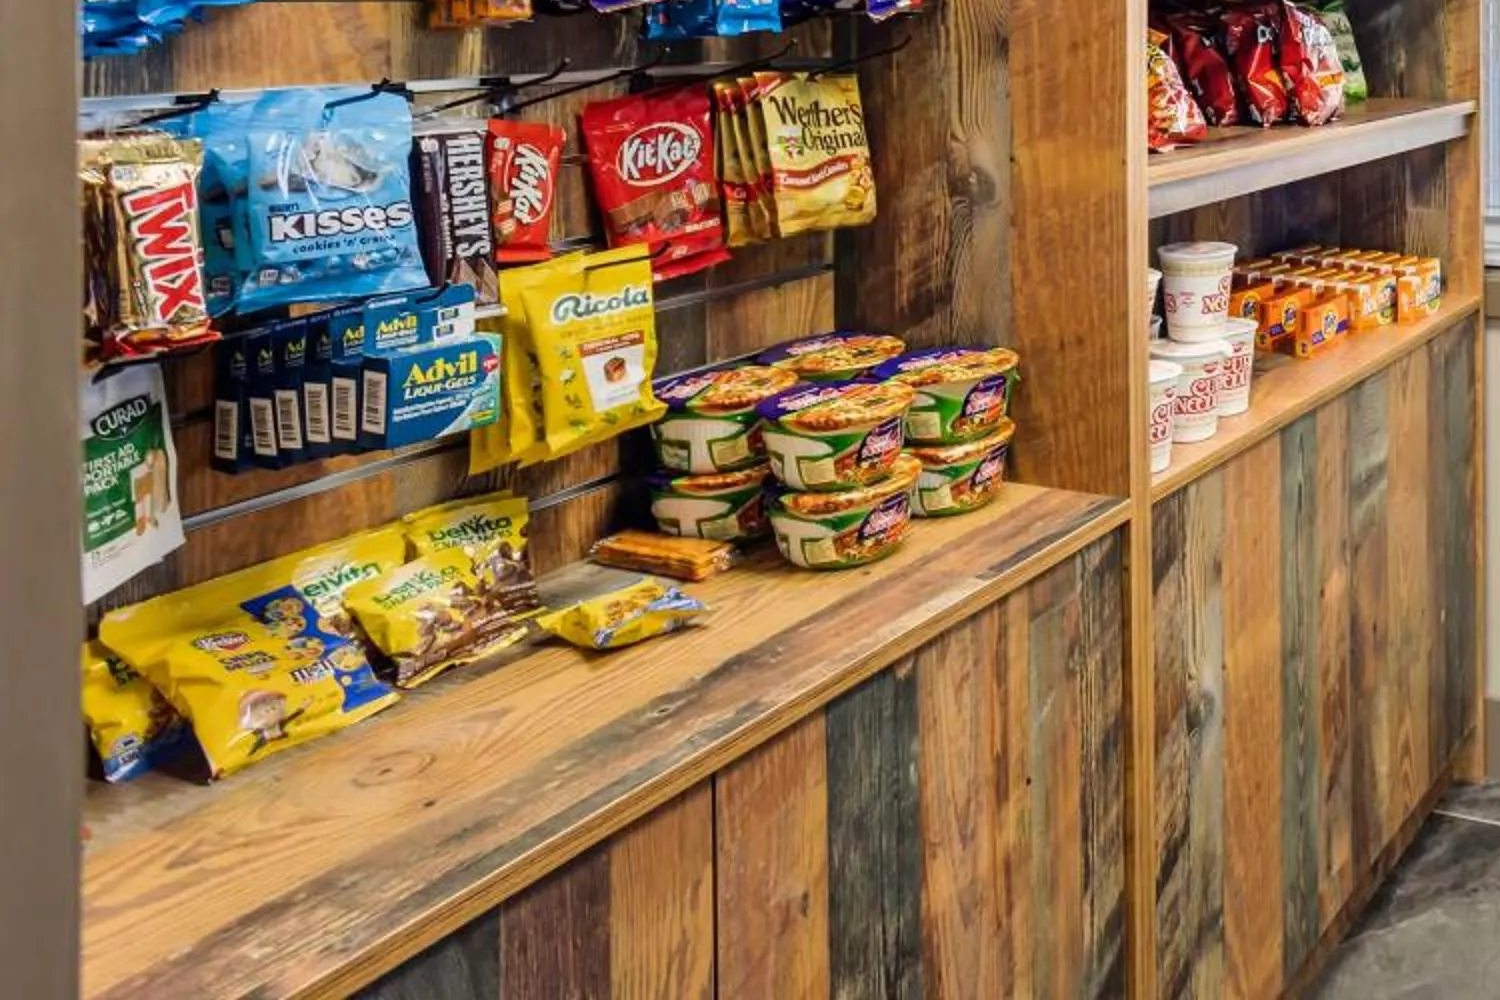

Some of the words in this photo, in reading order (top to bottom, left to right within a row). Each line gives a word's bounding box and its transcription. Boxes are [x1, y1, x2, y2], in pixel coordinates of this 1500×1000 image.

[446, 134, 491, 258] HERSHEY'S
[127, 180, 203, 321] TWIX
[553, 286, 649, 323] Ricola
[403, 351, 478, 387] Advil
[96, 398, 148, 436] CURAD
